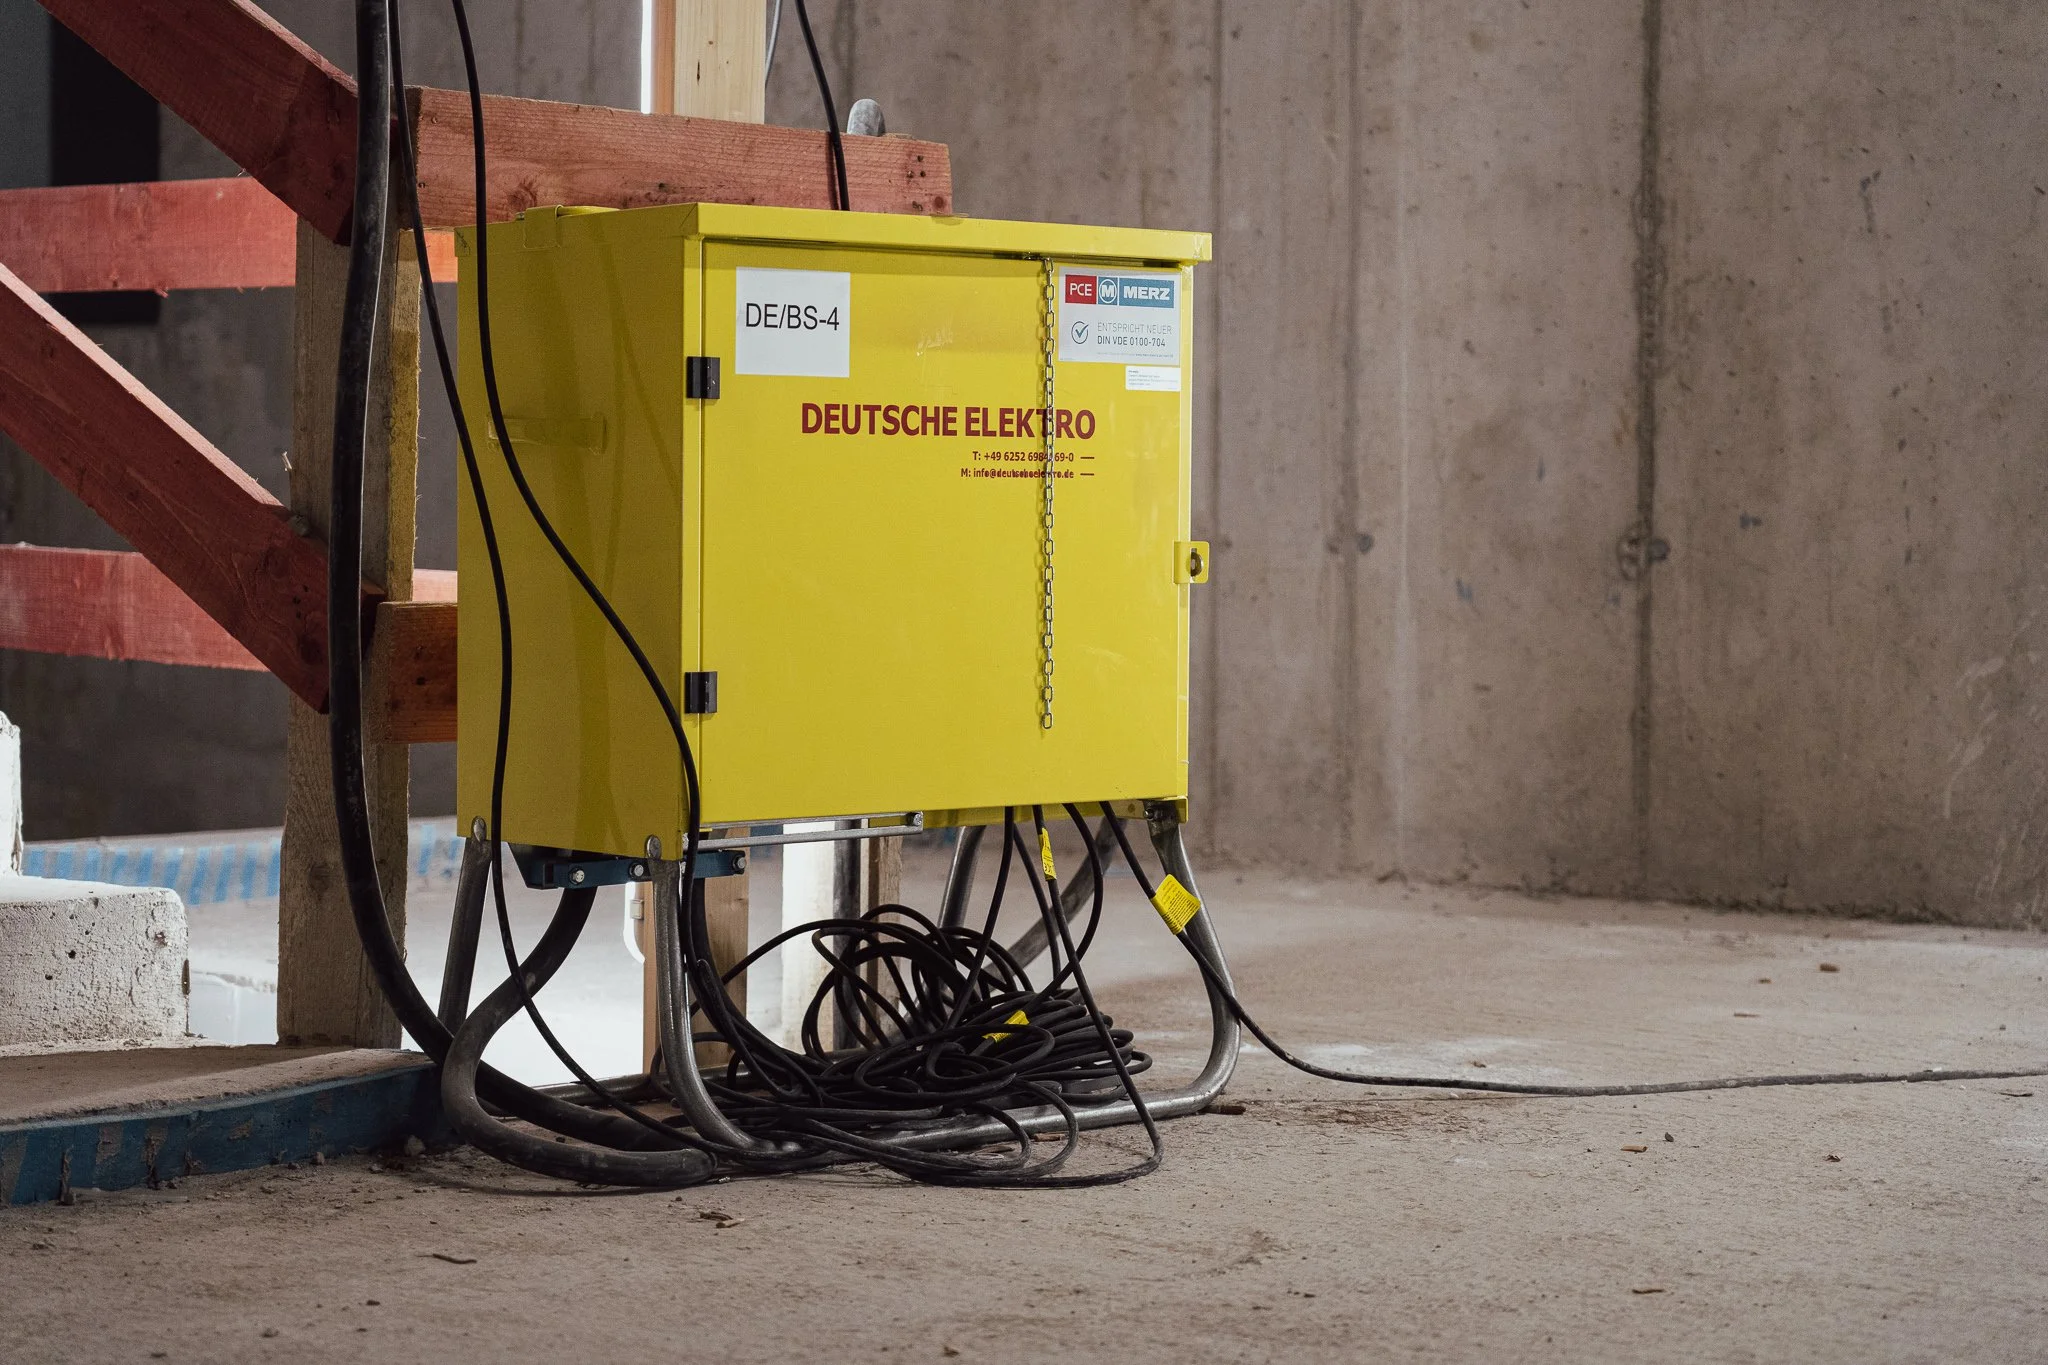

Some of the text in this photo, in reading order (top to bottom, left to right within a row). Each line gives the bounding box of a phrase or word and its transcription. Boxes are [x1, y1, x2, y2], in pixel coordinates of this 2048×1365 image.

[1069, 283, 1093, 296] PCE
[1123, 285, 1170, 301] MERZ
[745, 303, 841, 331] DE/BS-4
[1097, 321, 1172, 335] ENTSPRICHT NEUER
[1097, 336, 1166, 347] DIN VDE 0100-704
[801, 402, 1096, 440] DEUTSCHE ELEKTRO
[972, 451, 1074, 462] T: +49 6252 698469-0
[961, 468, 971, 478] M:
